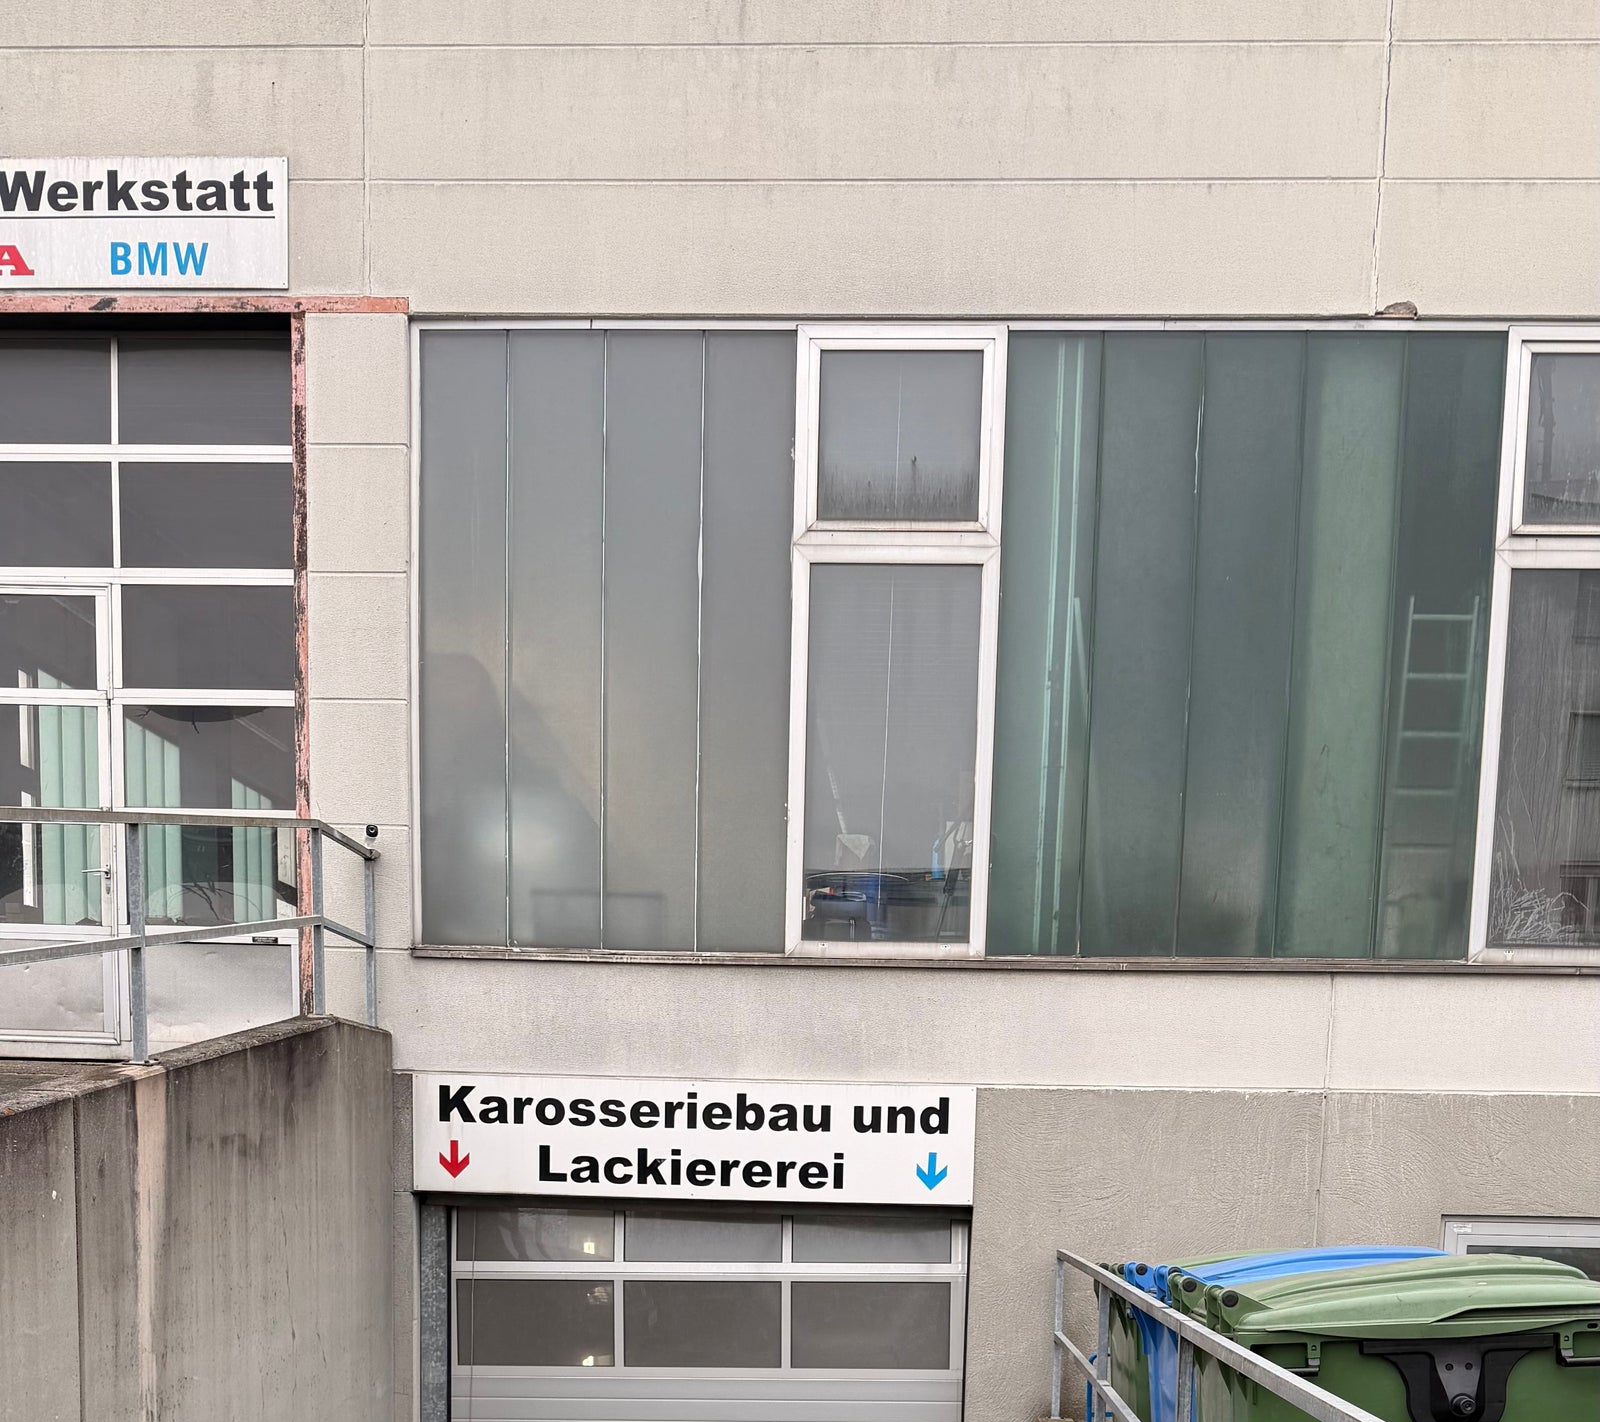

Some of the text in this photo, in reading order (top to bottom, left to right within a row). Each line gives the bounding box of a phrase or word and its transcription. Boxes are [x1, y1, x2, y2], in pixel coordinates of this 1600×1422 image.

[0, 169, 274, 212] Werkstatt
[110, 241, 209, 276] BMW
[438, 1084, 950, 1135] Karosseriebau und
[538, 1144, 844, 1190] Lackiererei
